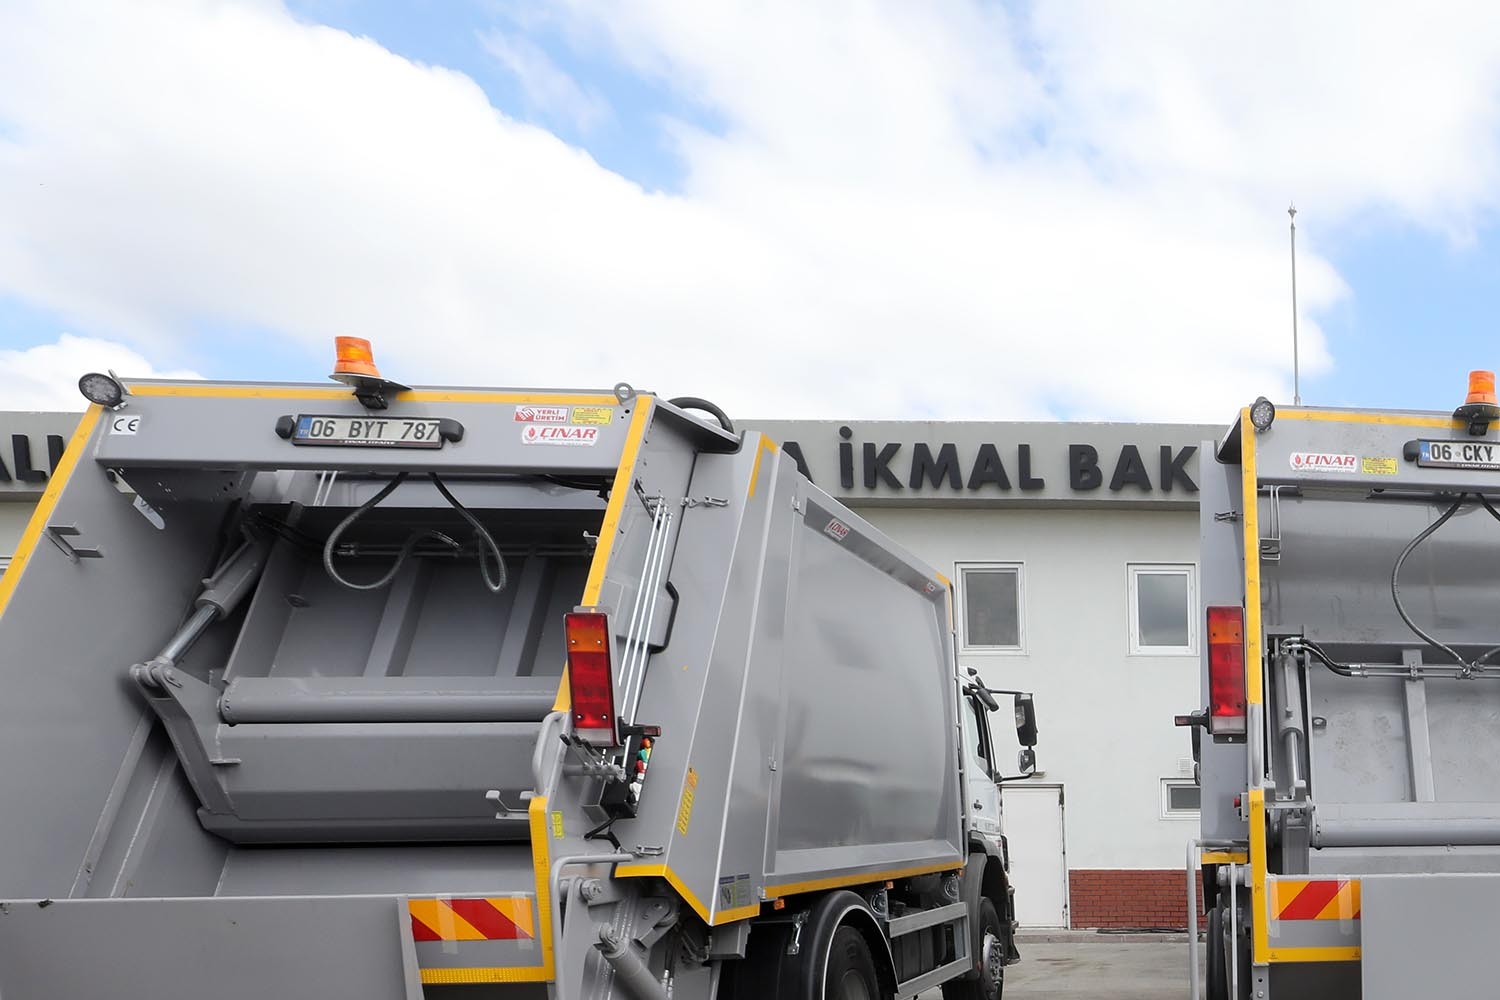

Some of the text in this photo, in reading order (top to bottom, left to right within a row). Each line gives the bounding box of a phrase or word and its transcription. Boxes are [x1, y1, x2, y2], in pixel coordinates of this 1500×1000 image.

[113, 418, 139, 432] CE
[310, 419, 440, 441] 06 BYT 787
[540, 427, 597, 440] ÇINAR
[839, 425, 1046, 491] İKMAL
[1068, 444, 1200, 492] BAK
[1431, 444, 1452, 460] 06
[1463, 445, 1493, 461] CKY
